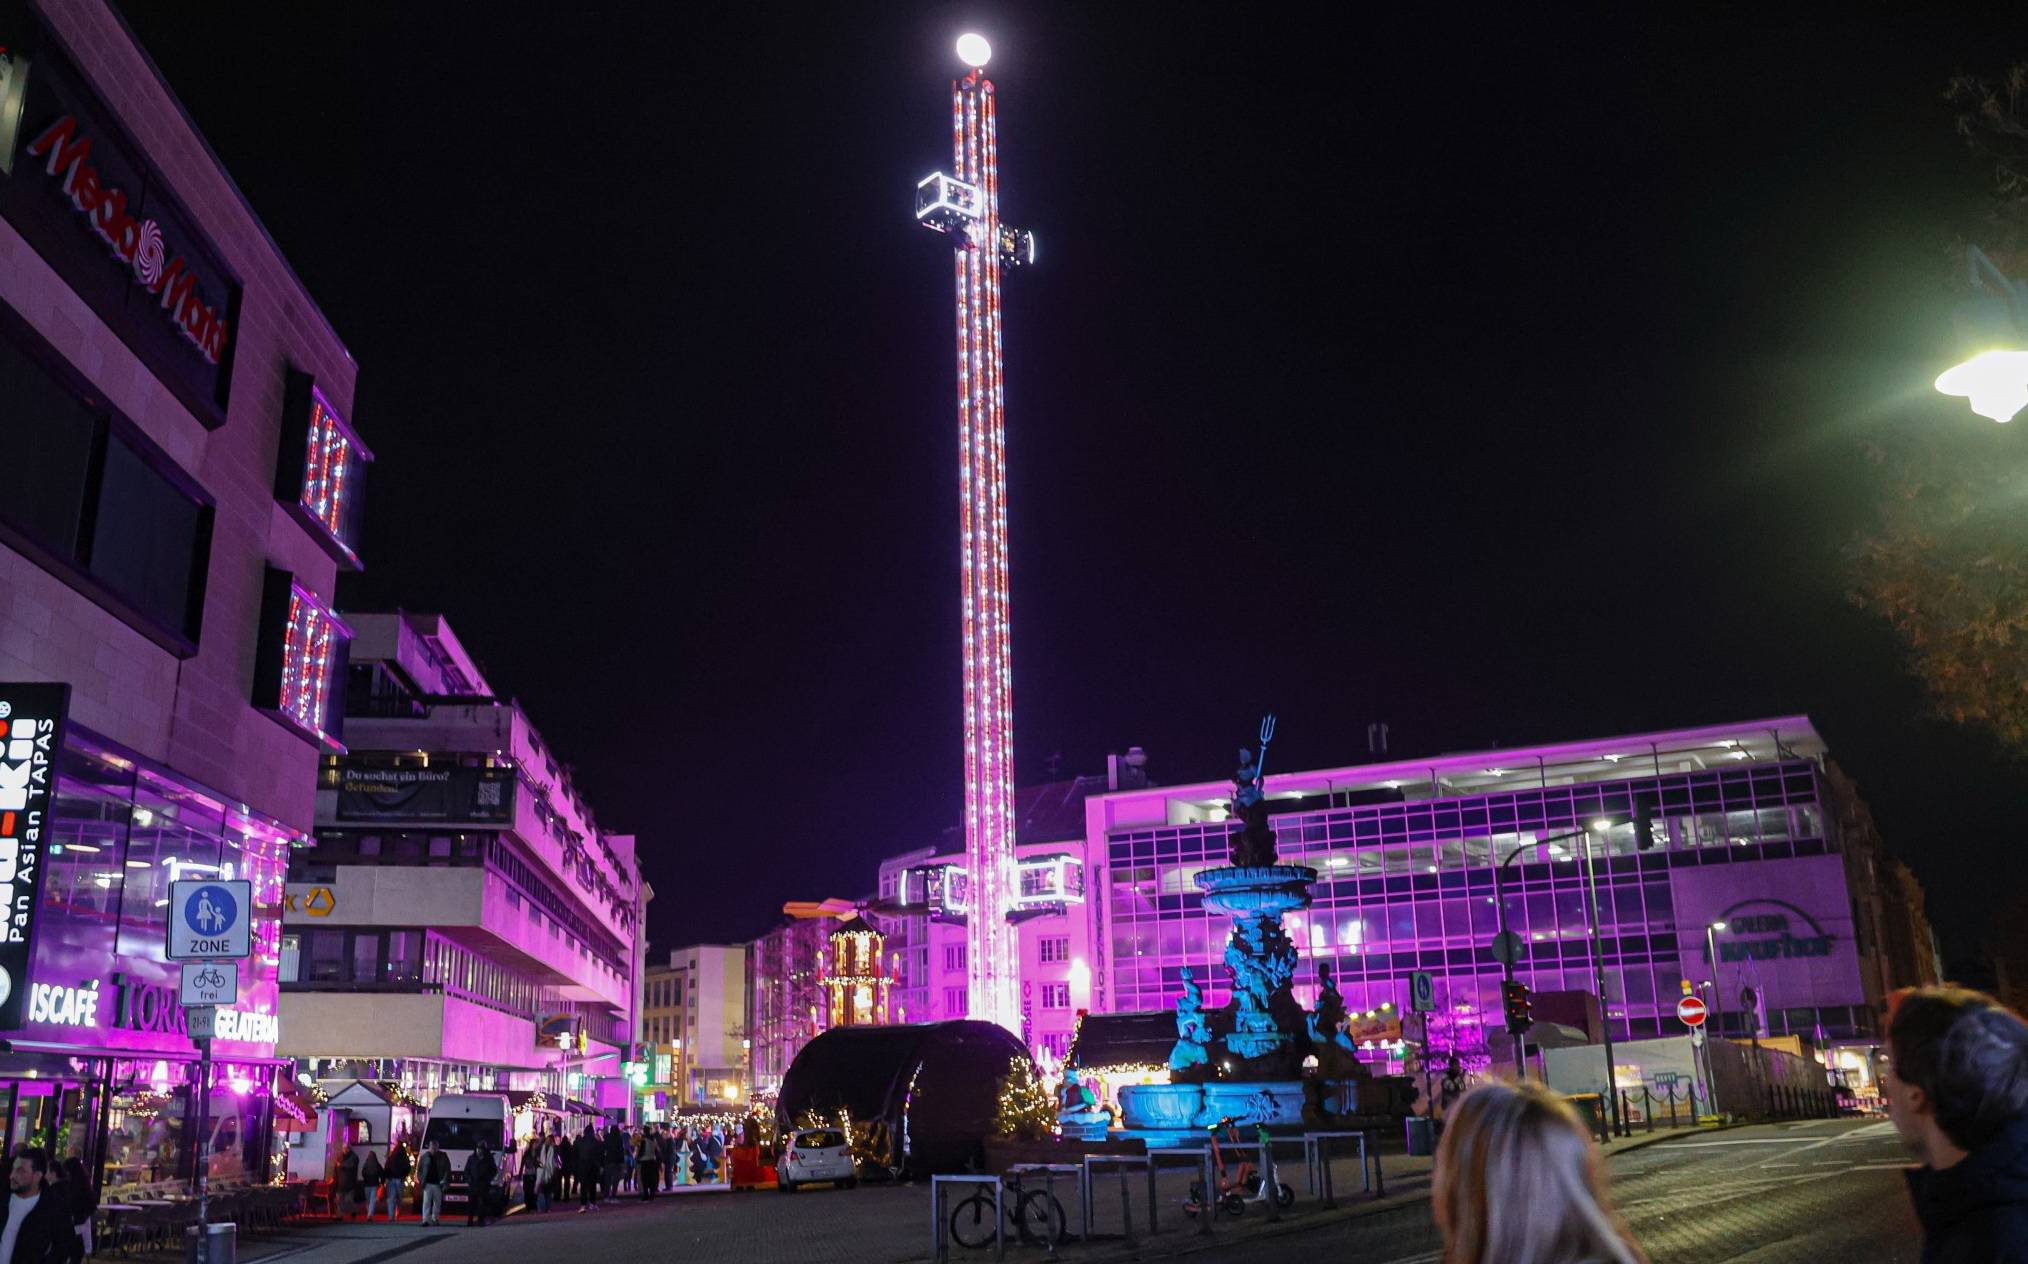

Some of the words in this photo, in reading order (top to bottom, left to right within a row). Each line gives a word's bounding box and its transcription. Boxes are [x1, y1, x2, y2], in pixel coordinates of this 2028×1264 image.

[28, 718, 54, 800] TAPAS
[17, 810, 42, 885] Asian
[9, 895, 30, 943] Pan
[190, 939, 231, 953] ZONE
[28, 979, 99, 1027] ISCAFÉ
[200, 990, 218, 1000] frei
